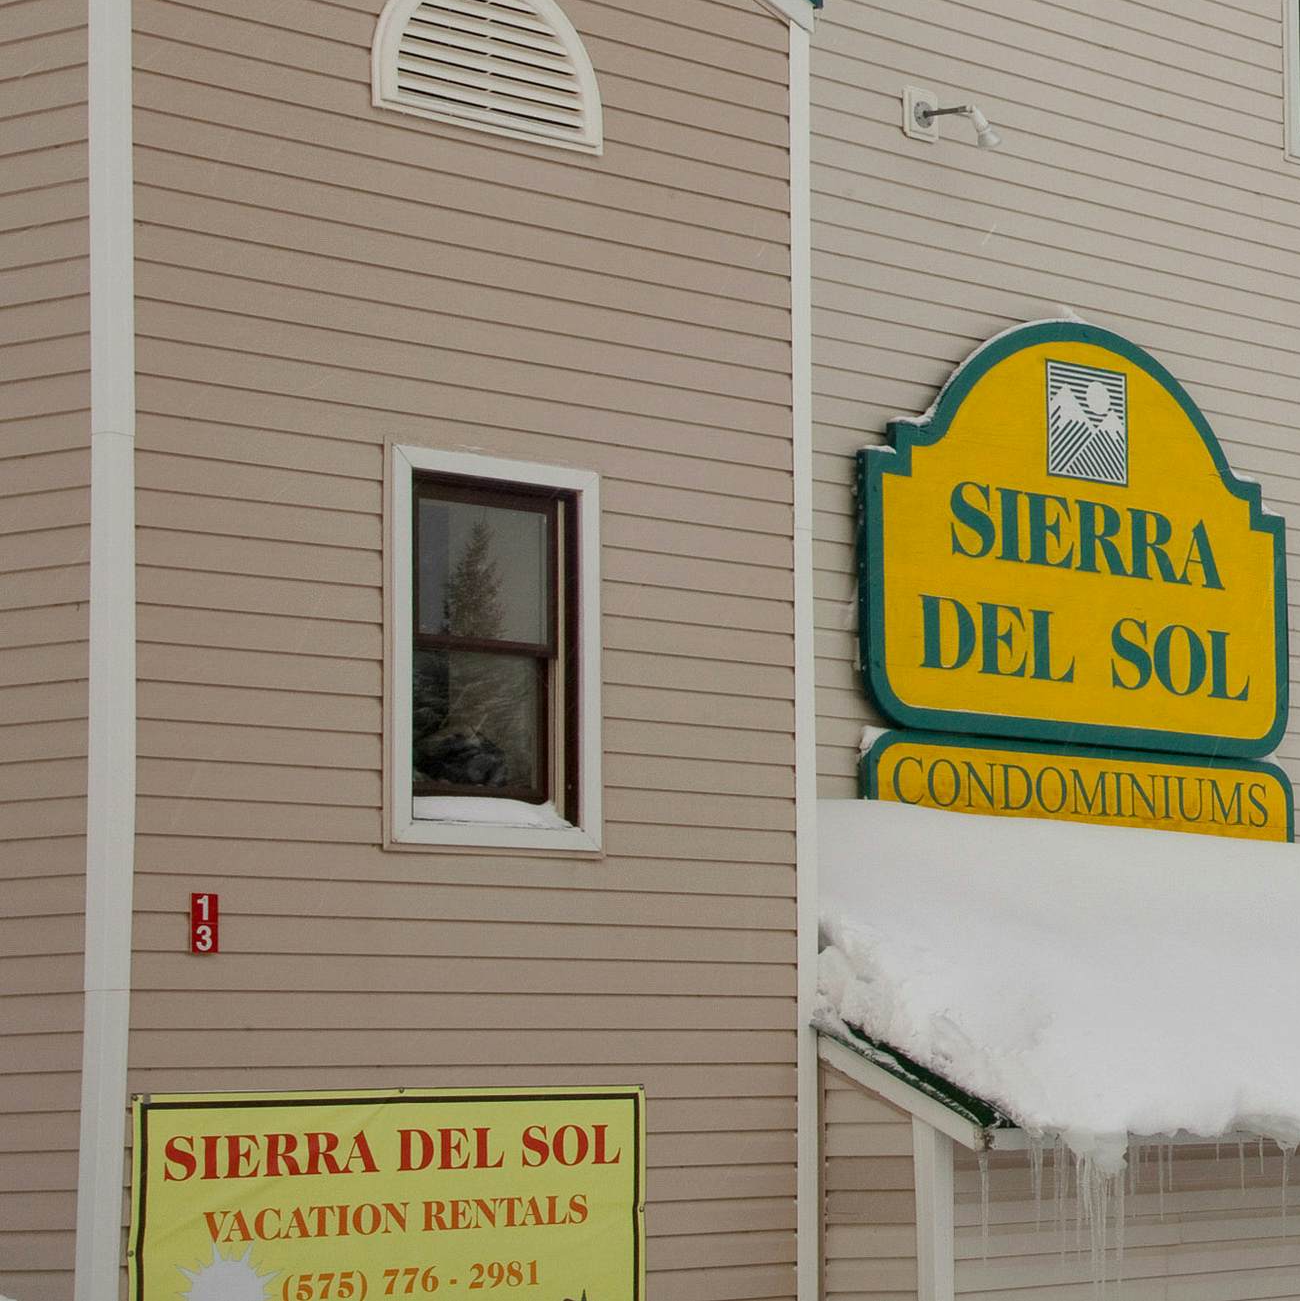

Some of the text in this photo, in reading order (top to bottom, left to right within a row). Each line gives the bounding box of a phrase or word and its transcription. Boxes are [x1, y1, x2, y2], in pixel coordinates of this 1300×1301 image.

[950, 480, 1225, 591] SIERRA
[919, 594, 1250, 701] DEL SOL
[892, 756, 1269, 827] CONDOMINIUMS
[163, 1124, 622, 1182] SIERRA DEL SOL
[203, 1194, 589, 1243] VACATION RENTALS
[282, 1270, 368, 1301] (575)
[383, 1266, 439, 1293] 776
[469, 1260, 540, 1290] 2981
